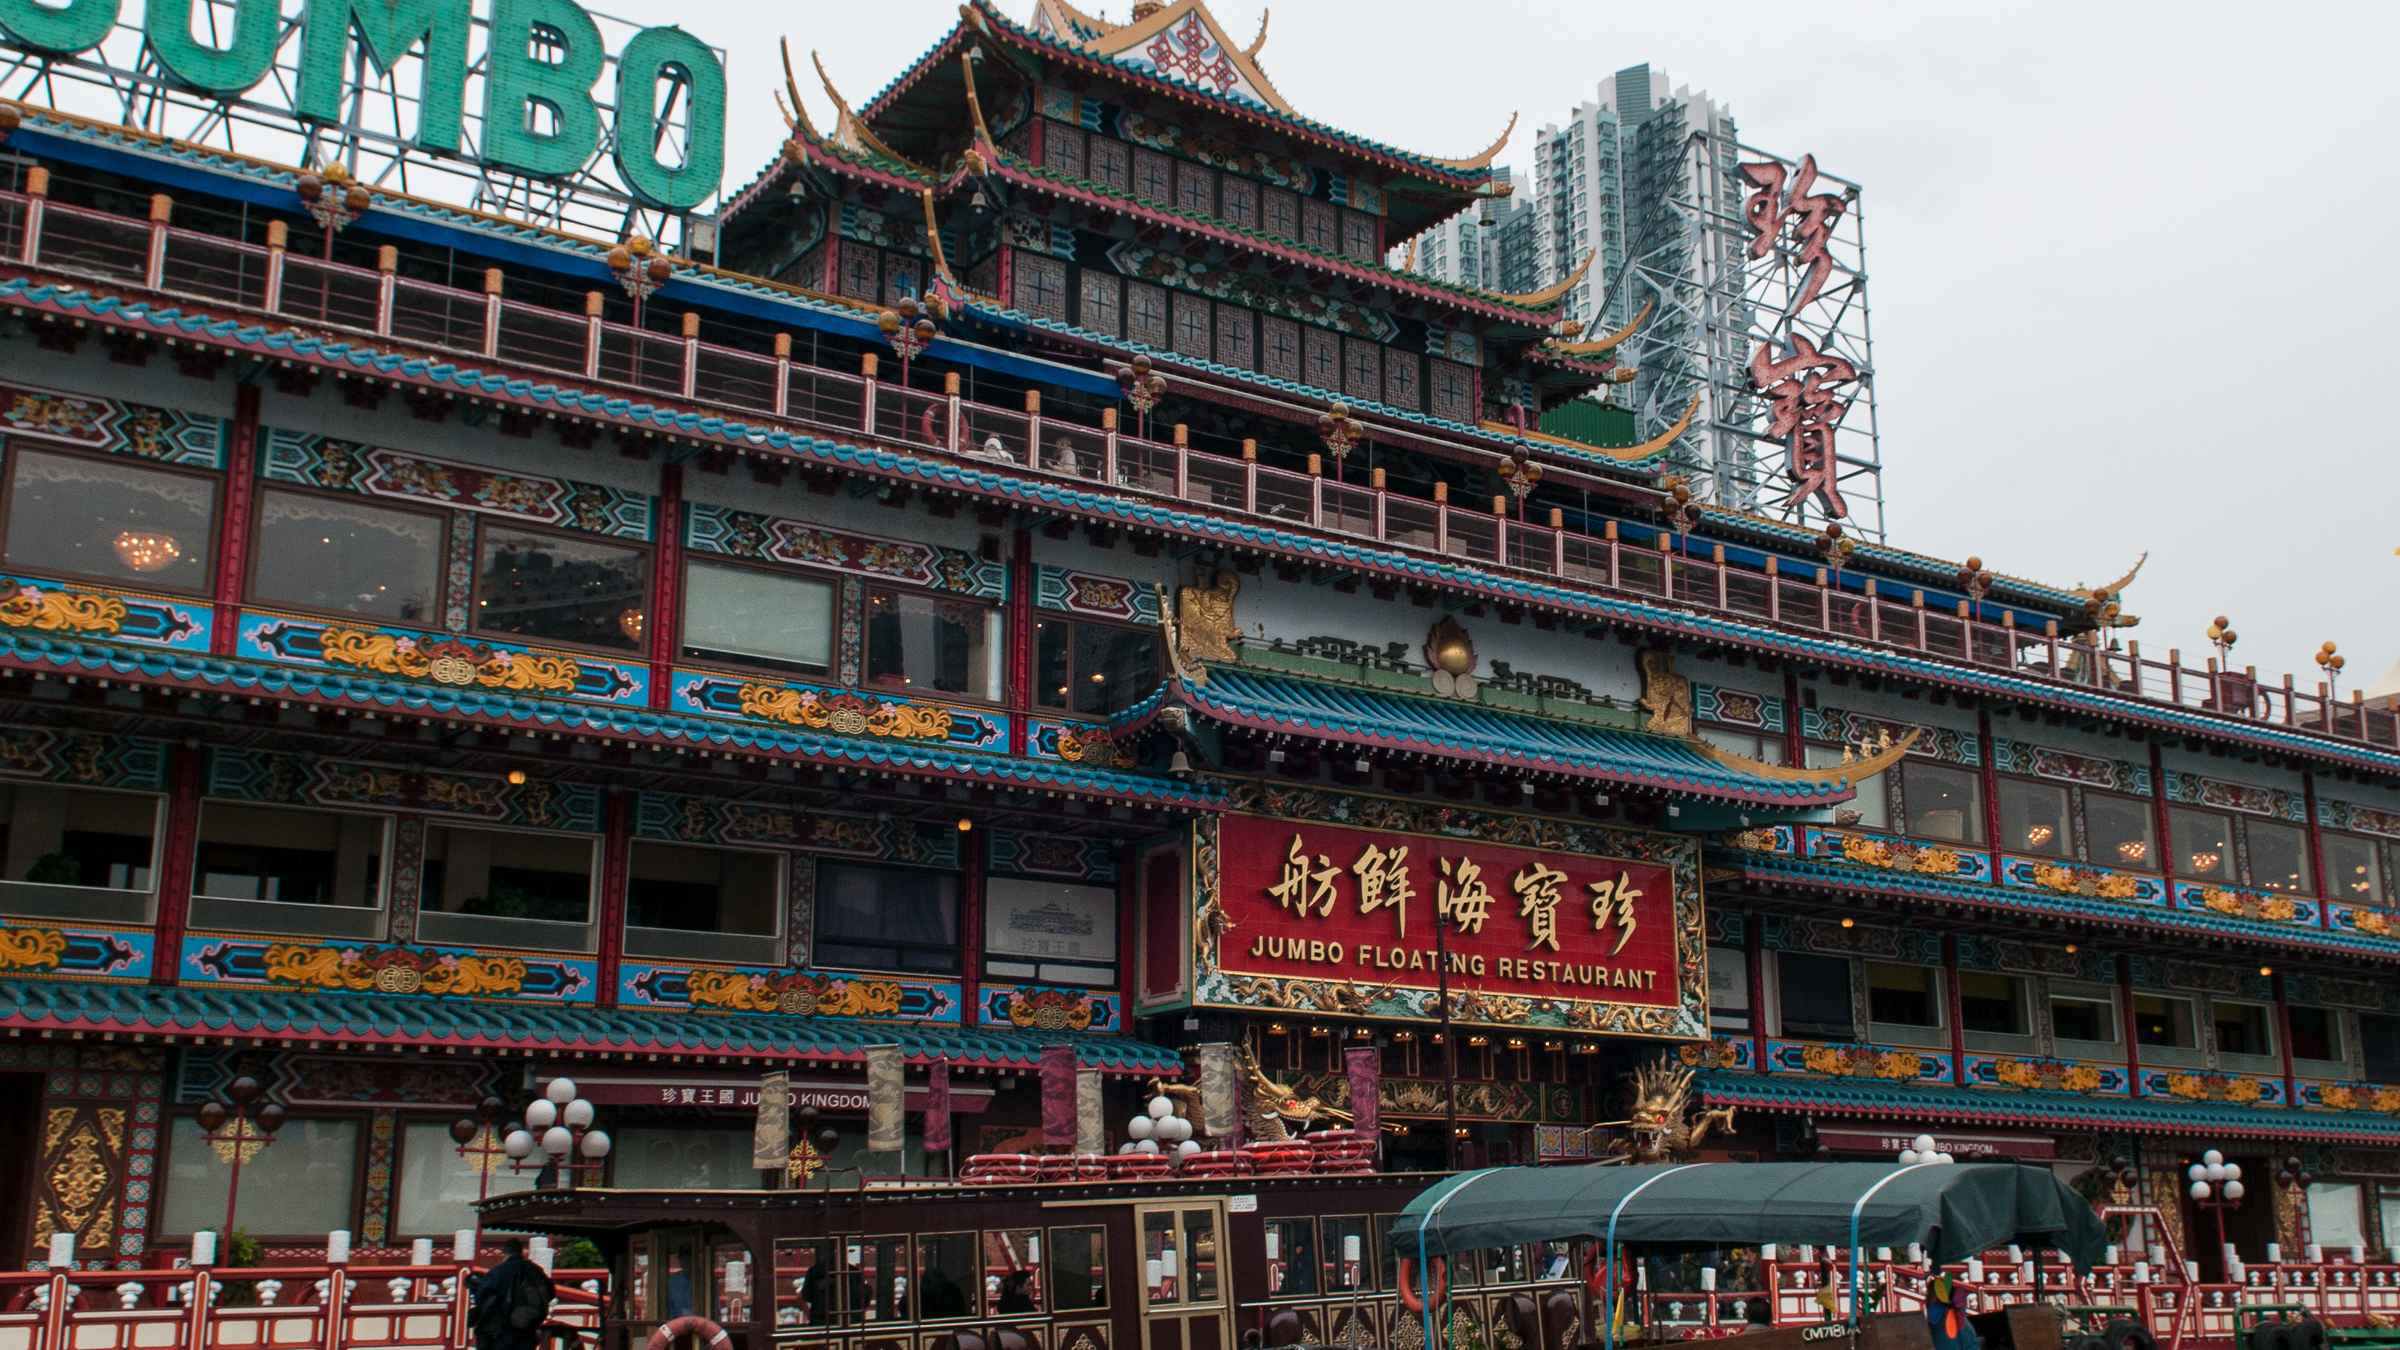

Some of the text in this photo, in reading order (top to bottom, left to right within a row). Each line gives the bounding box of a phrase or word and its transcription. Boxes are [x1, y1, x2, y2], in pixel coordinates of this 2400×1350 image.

[0, 0, 730, 213] UMBO
[1252, 935, 1344, 964] JUMBO
[1499, 957, 1657, 990] RESTAURANT
[661, 1088, 736, 1104] 珍寶王國
[741, 1091, 796, 1106] JUO
